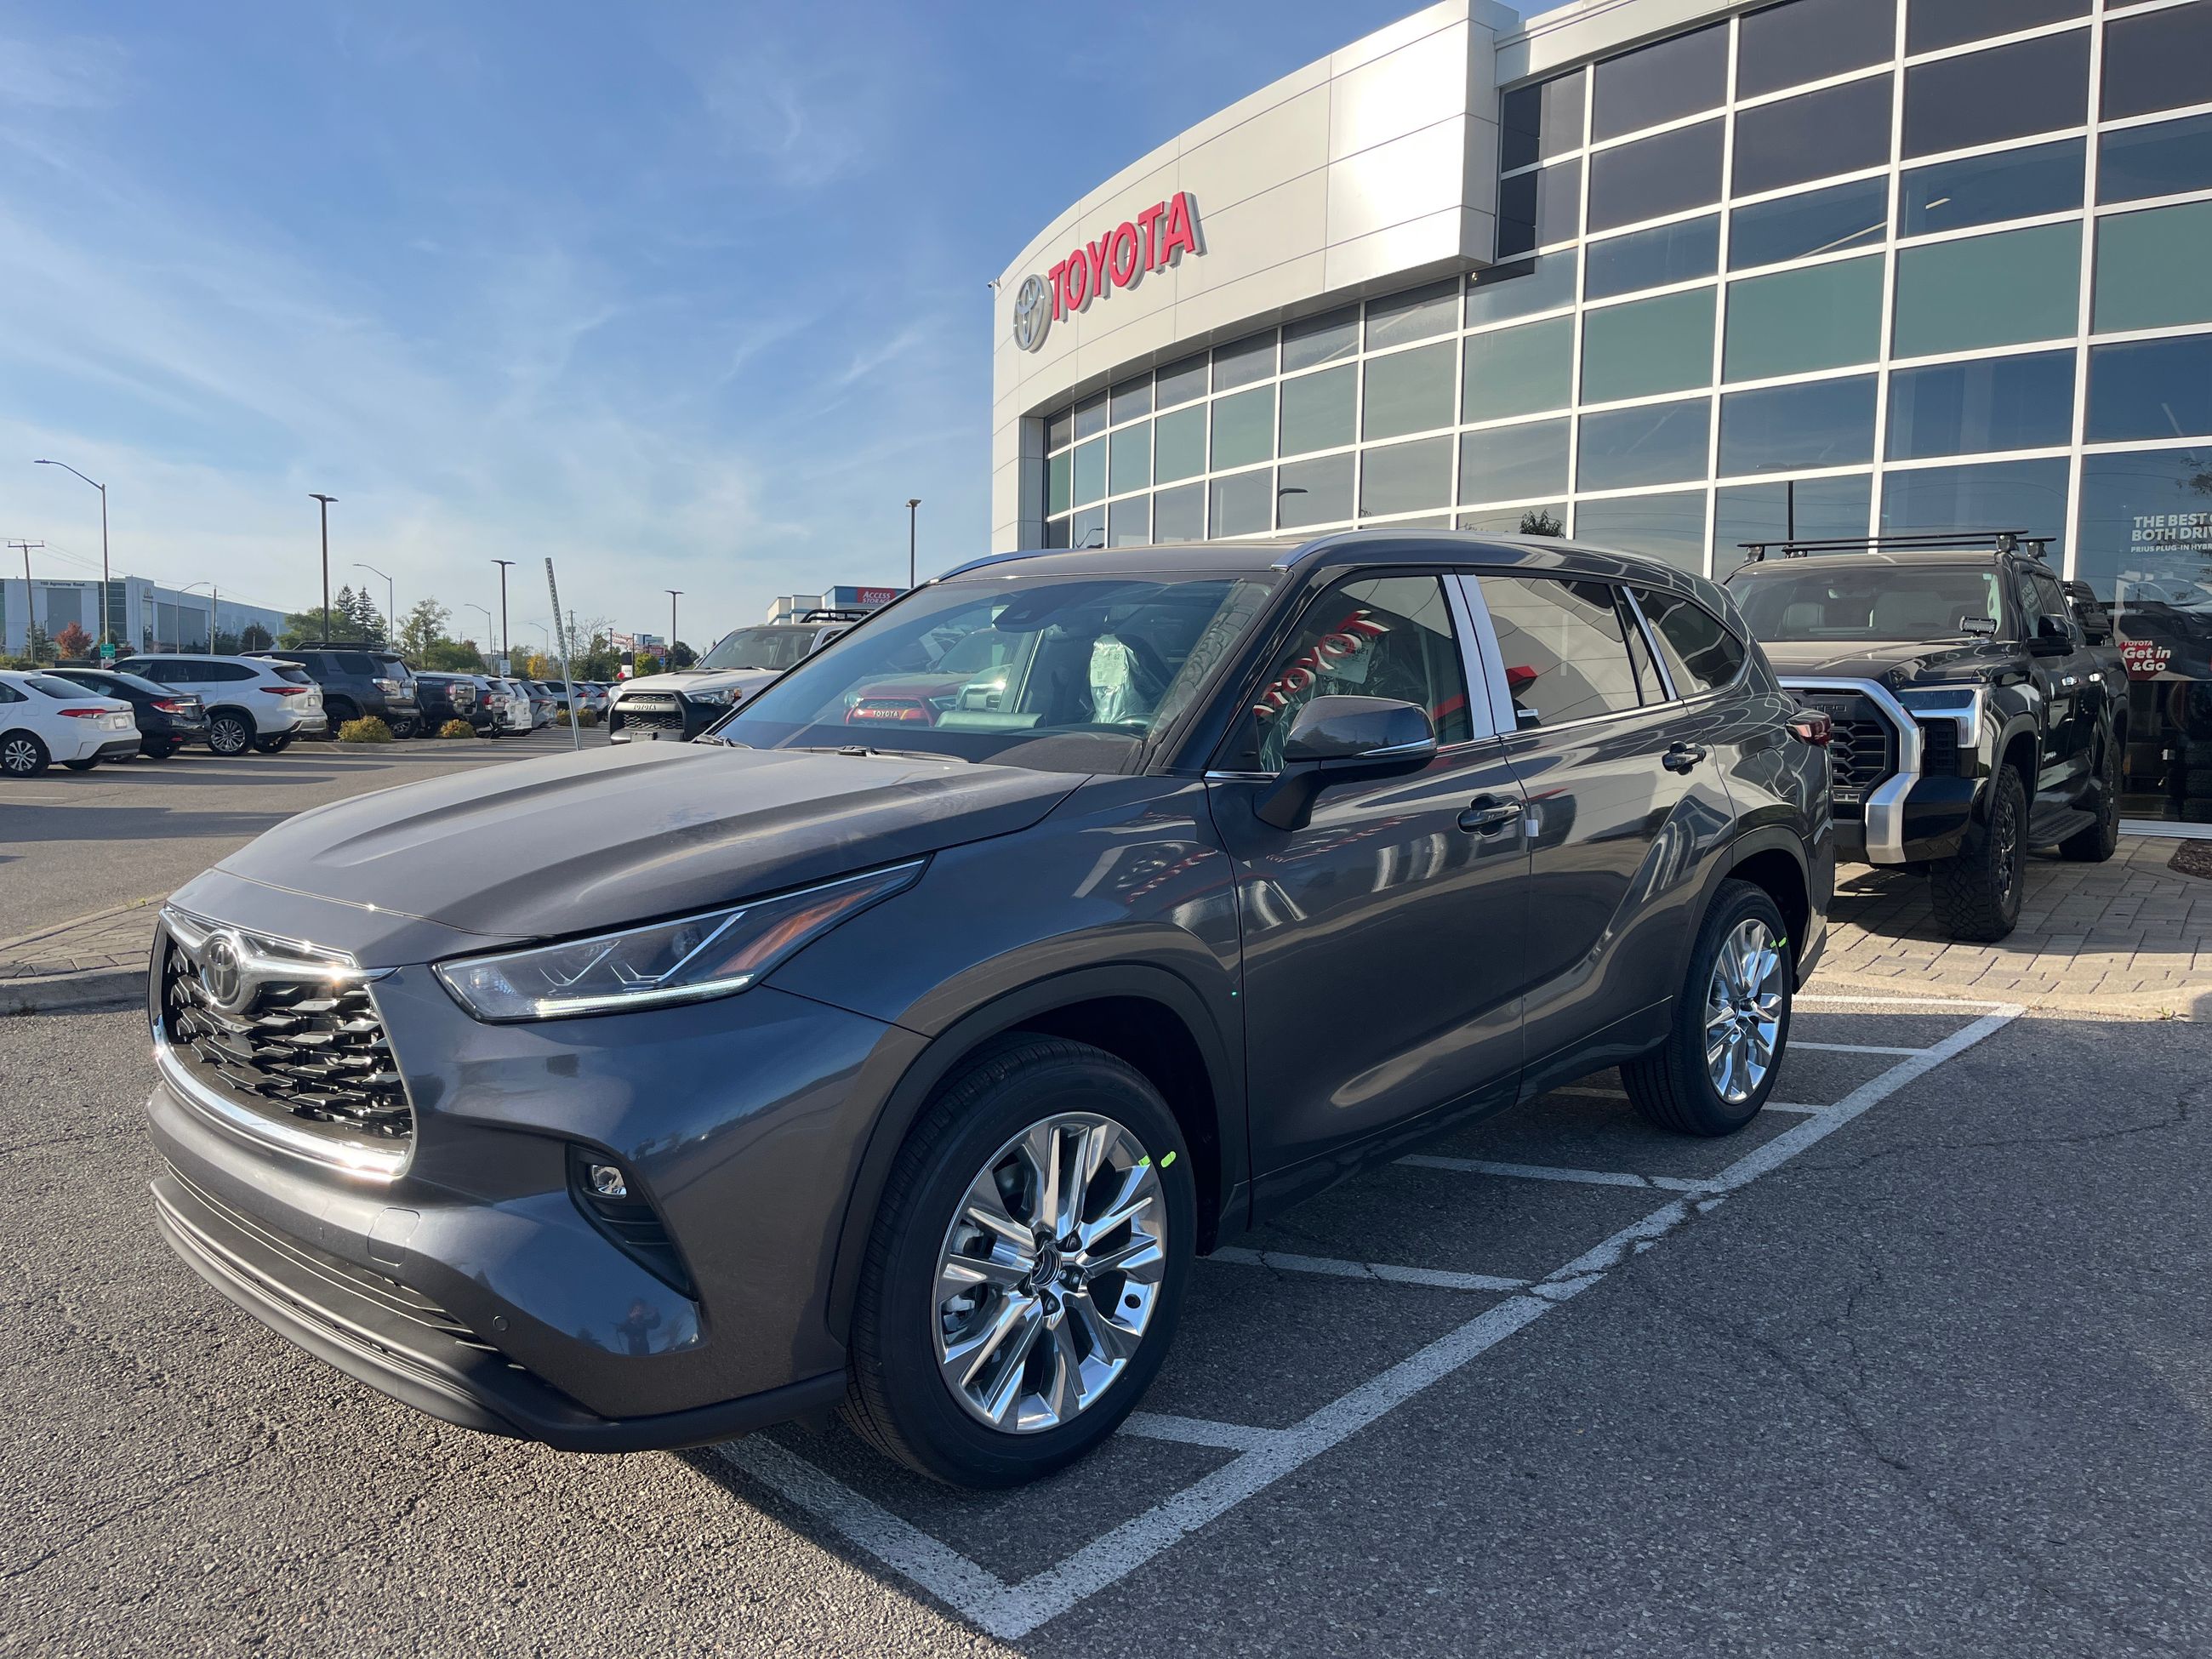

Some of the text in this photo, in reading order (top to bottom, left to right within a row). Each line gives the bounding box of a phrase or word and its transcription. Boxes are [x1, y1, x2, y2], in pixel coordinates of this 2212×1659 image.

[1048, 191, 1201, 322] TOYOTA
[2134, 515, 2164, 527] THE
[2168, 513, 2207, 526] BEST
[2132, 528, 2175, 541] BOTH
[863, 590, 891, 599] ACCESS
[2123, 646, 2171, 658] Get in
[2132, 659, 2166, 670] &Go
